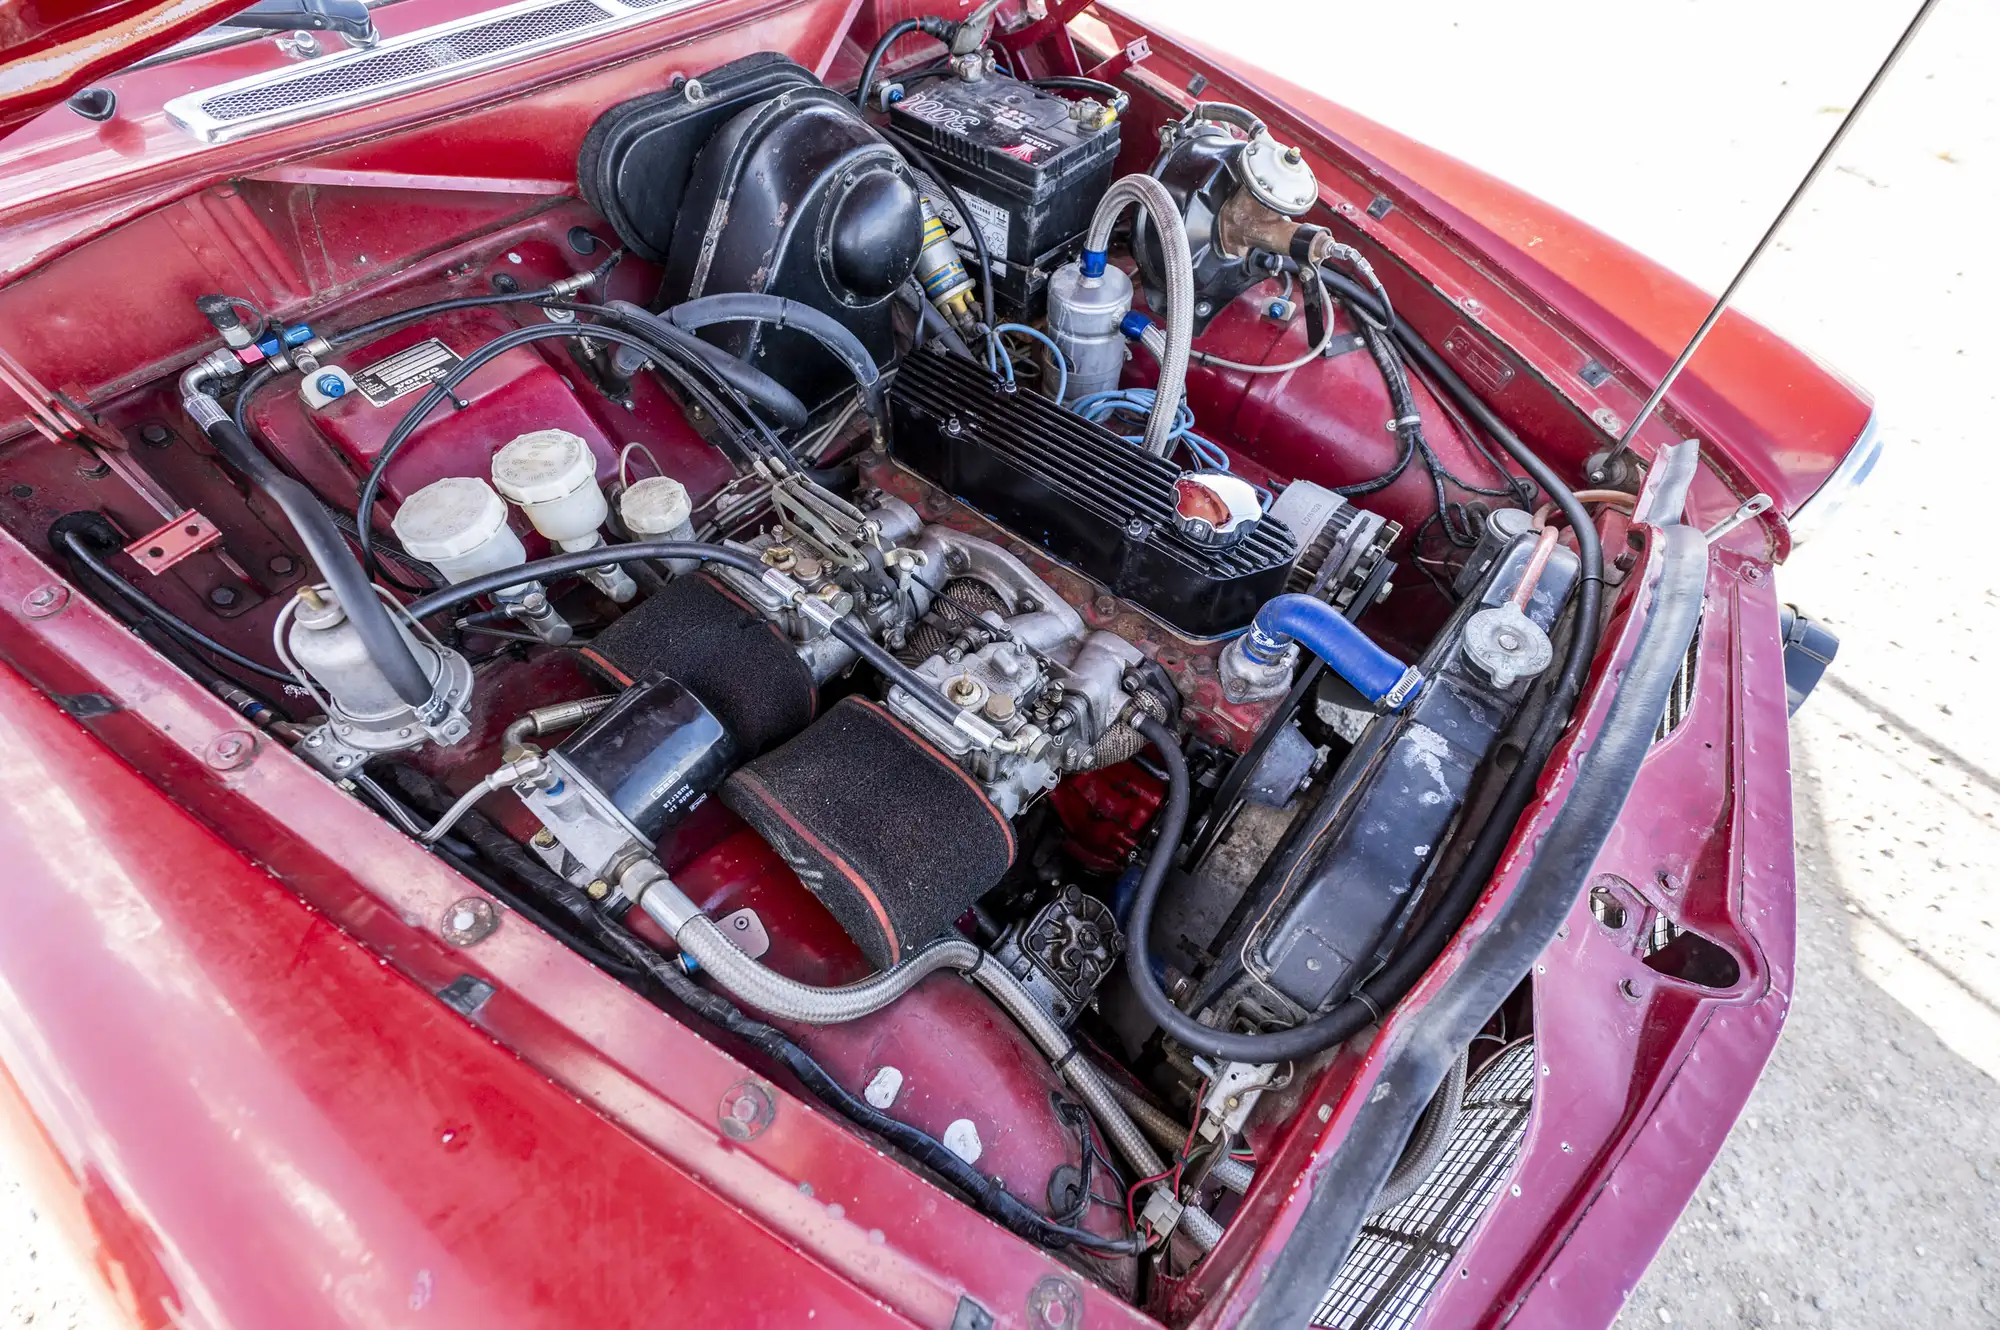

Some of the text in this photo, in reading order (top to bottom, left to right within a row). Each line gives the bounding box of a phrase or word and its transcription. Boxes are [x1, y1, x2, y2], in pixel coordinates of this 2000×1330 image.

[1021, 134, 1052, 151] YUASA
[394, 367, 440, 389] VOLVO
[662, 783, 690, 809] Austria
[678, 788, 695, 804] Made
[668, 804, 678, 813] in
